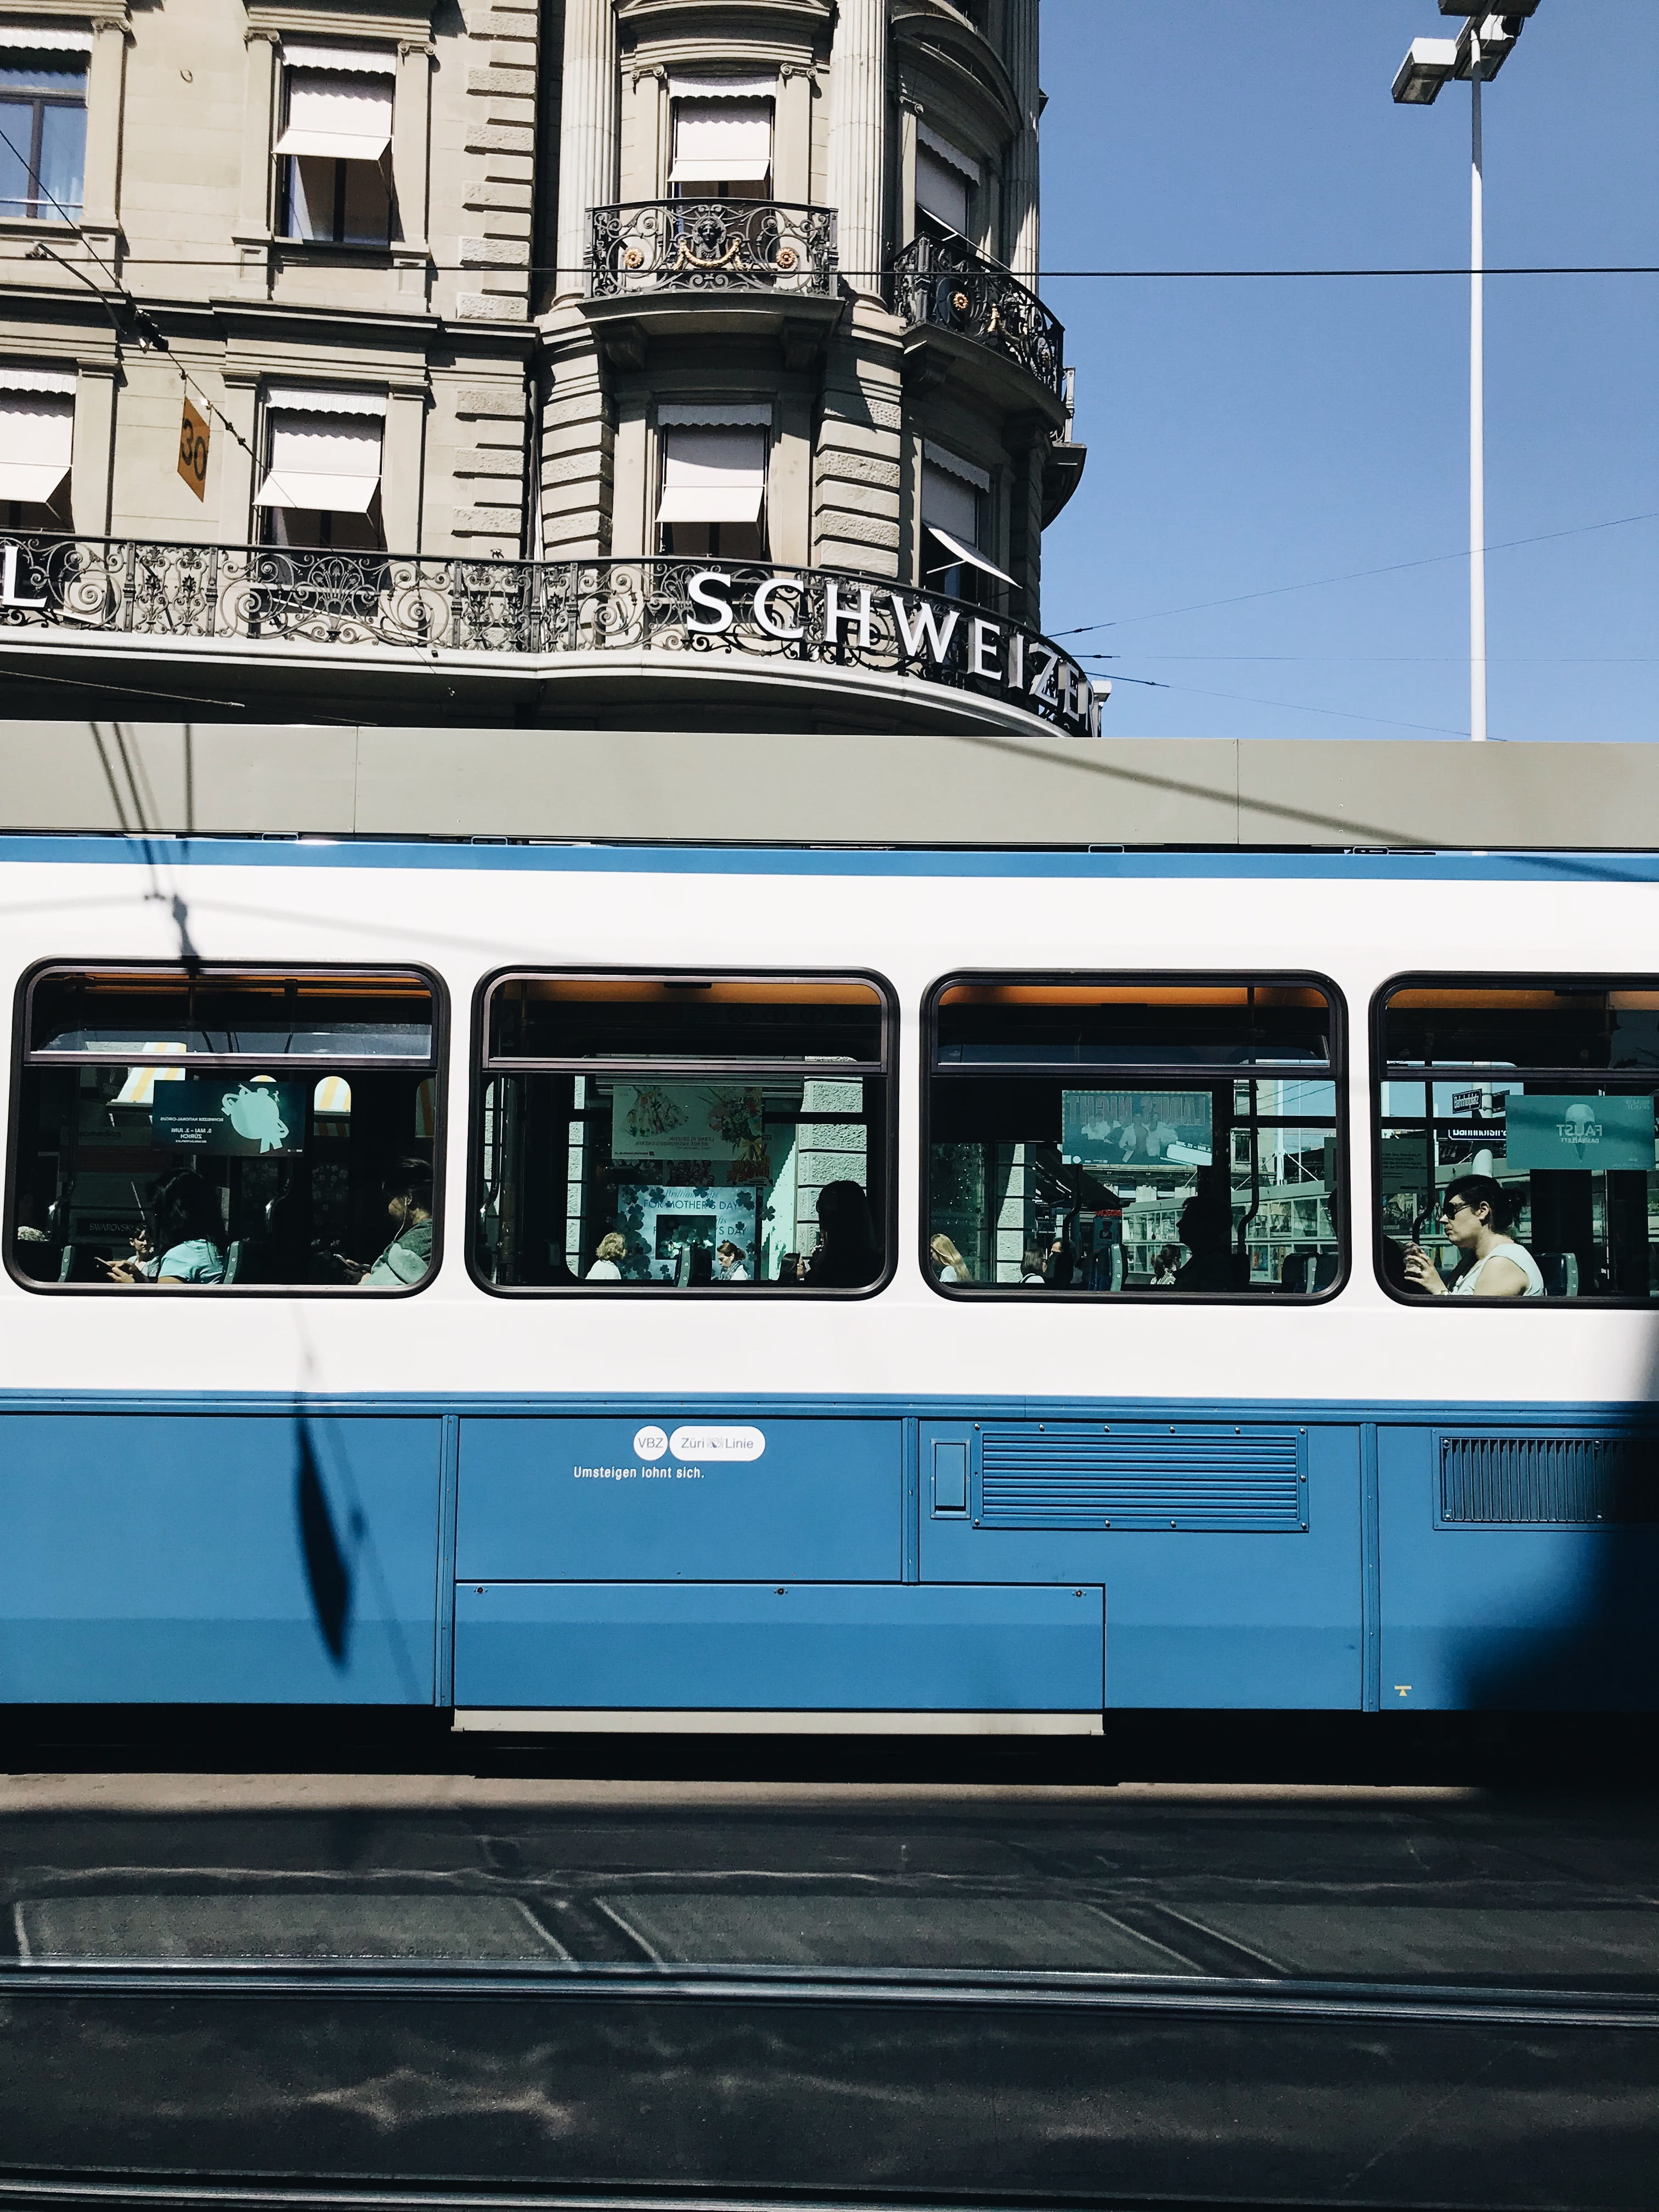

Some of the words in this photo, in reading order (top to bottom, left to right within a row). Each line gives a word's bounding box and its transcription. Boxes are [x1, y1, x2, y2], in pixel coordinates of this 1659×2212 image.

[182, 417, 207, 482] 30
[686, 572, 1096, 737] SCHWEIZER
[1454, 1093, 1480, 1109] Bahnhofplatz
[665, 1189, 695, 1198] Brillian
[644, 1200, 663, 1208] FOR
[667, 1200, 716, 1210] MOTHERS
[719, 1201, 738, 1210] DAY
[638, 1438, 664, 1448] VBZ
[681, 1437, 704, 1448] Züri
[725, 1437, 754, 1448] Linie
[573, 1466, 636, 1480] Umsteigen
[642, 1466, 672, 1479] lohnt
[676, 1466, 704, 1479] sich.
